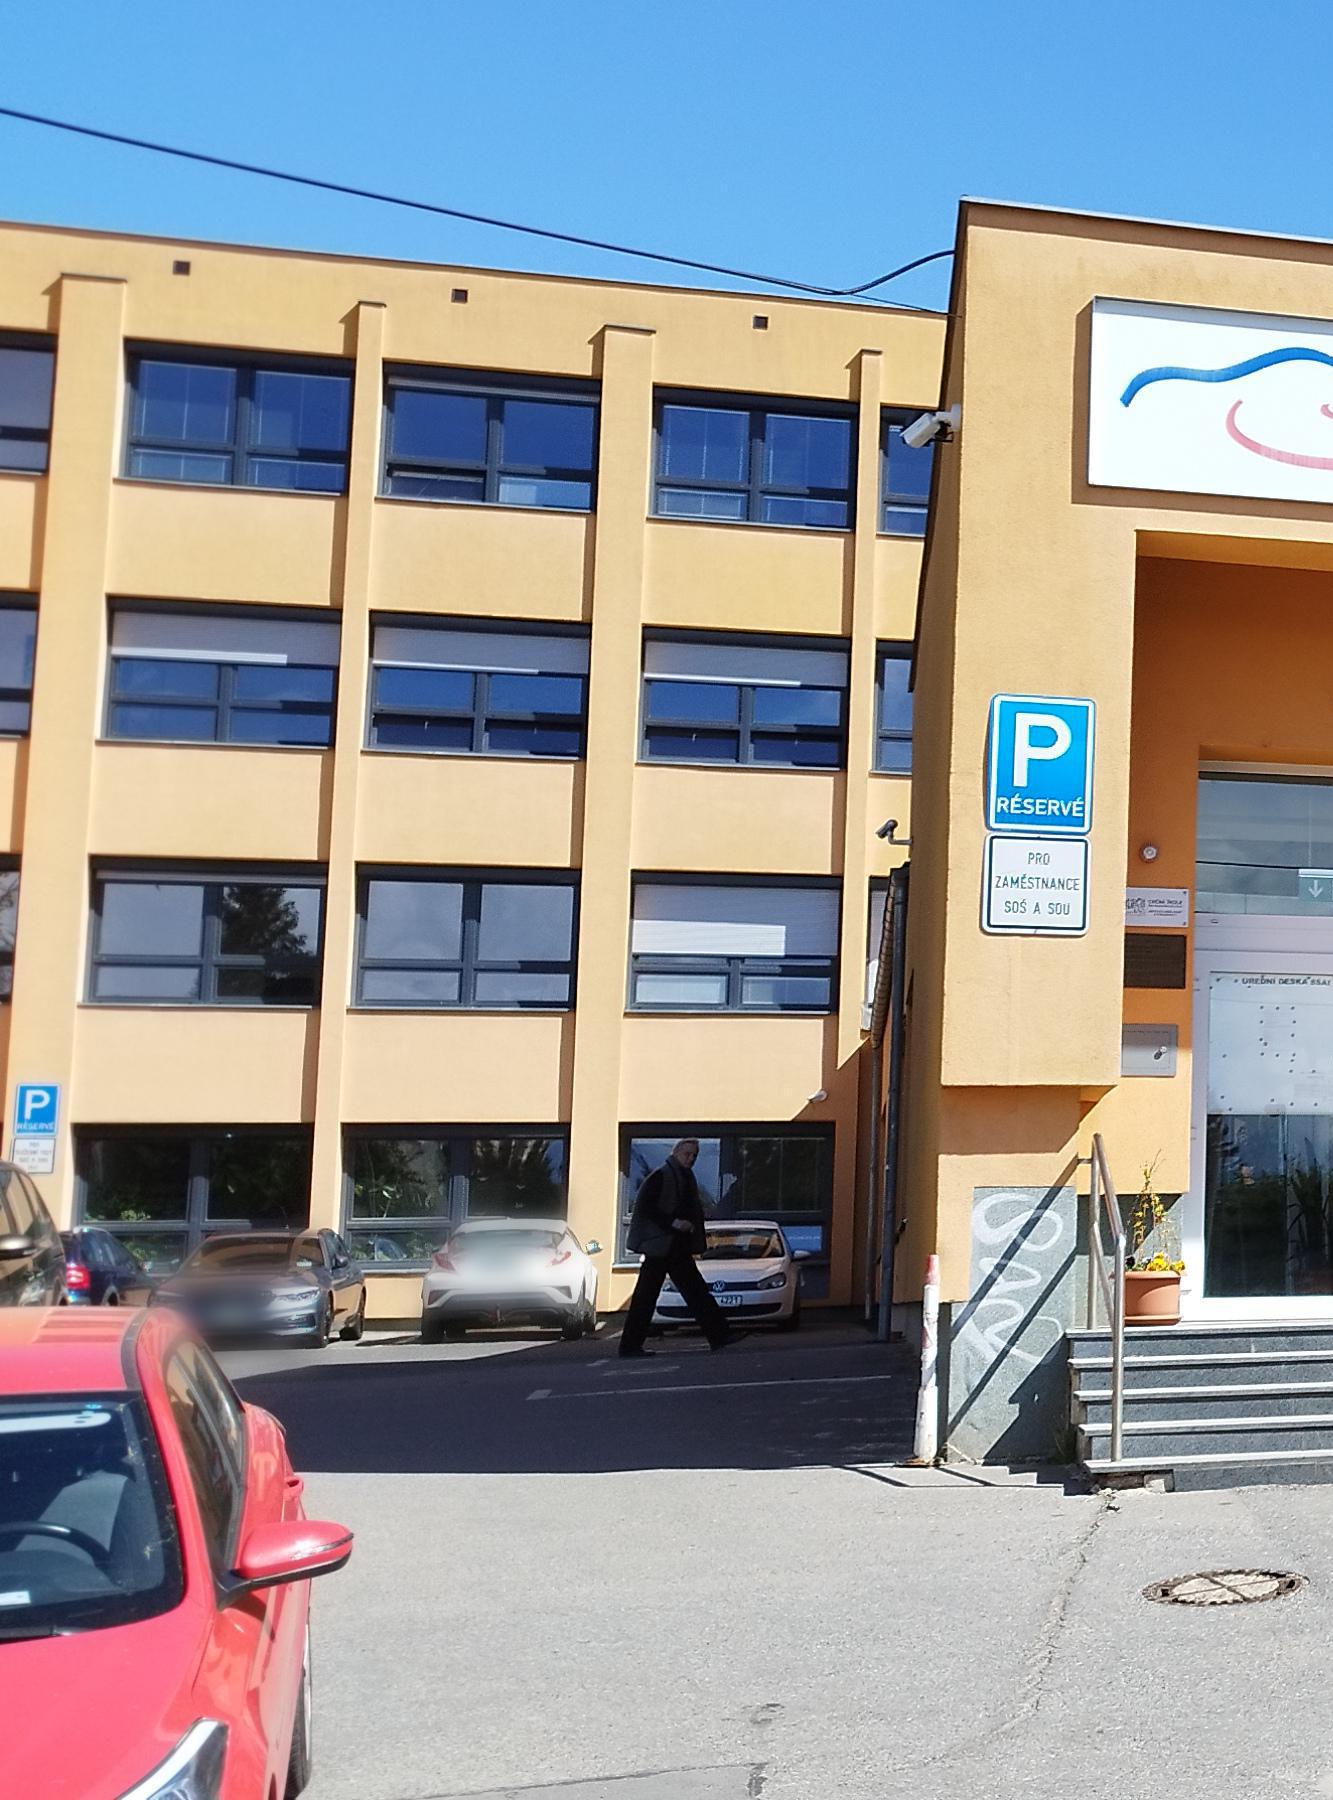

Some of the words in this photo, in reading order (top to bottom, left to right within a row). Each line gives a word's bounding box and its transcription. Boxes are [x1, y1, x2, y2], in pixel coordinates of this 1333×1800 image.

[1012, 712, 1072, 788] P
[996, 794, 1084, 817] RÉSERVÉ
[1027, 852, 1050, 866] PRO
[1032, 902, 1041, 914] A
[1048, 903, 1070, 915] SOU
[24, 1089, 51, 1120] P
